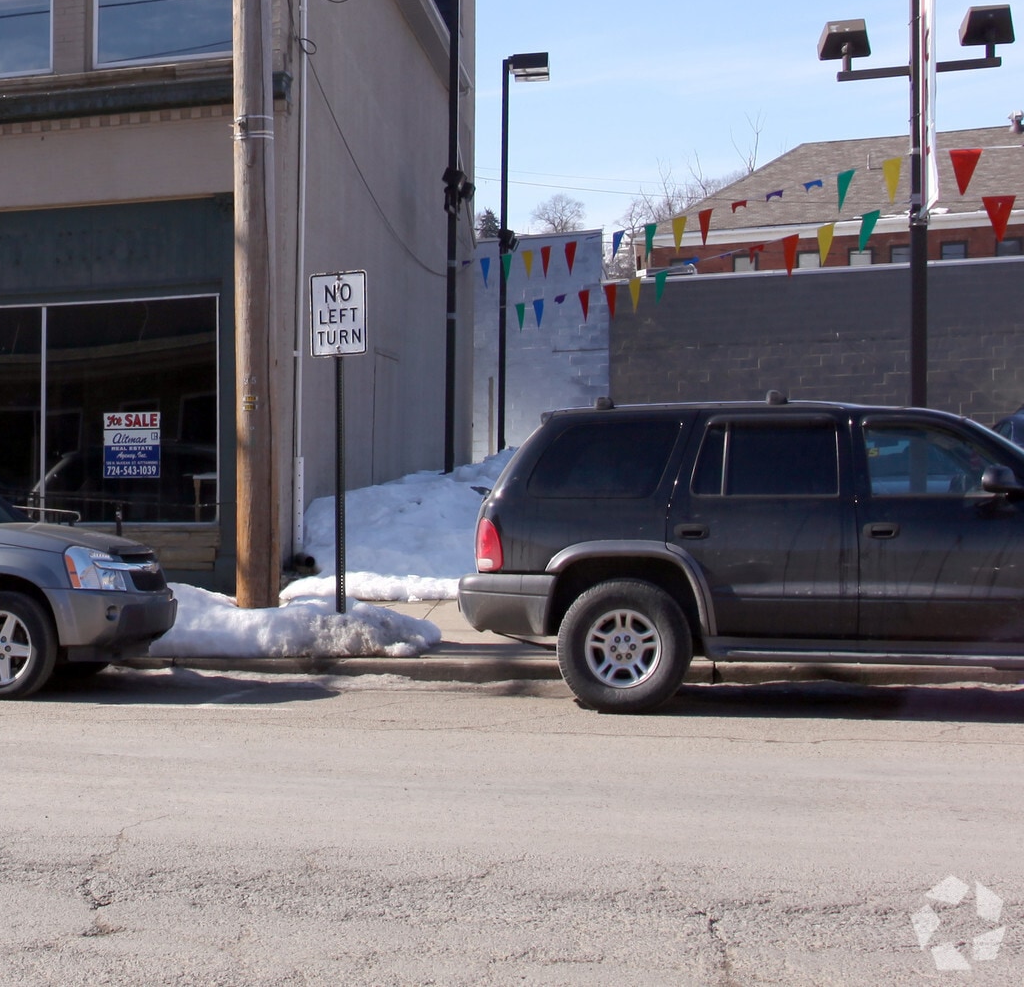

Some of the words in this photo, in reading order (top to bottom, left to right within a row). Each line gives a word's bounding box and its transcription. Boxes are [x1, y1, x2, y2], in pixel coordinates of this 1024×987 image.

[324, 283, 352, 304] NO
[319, 307, 358, 325] LEFT
[317, 328, 361, 346] TURN
[107, 414, 123, 427] For
[124, 413, 158, 427] SALE
[112, 432, 147, 444] Altman
[107, 465, 157, 476] 724-543-1039
